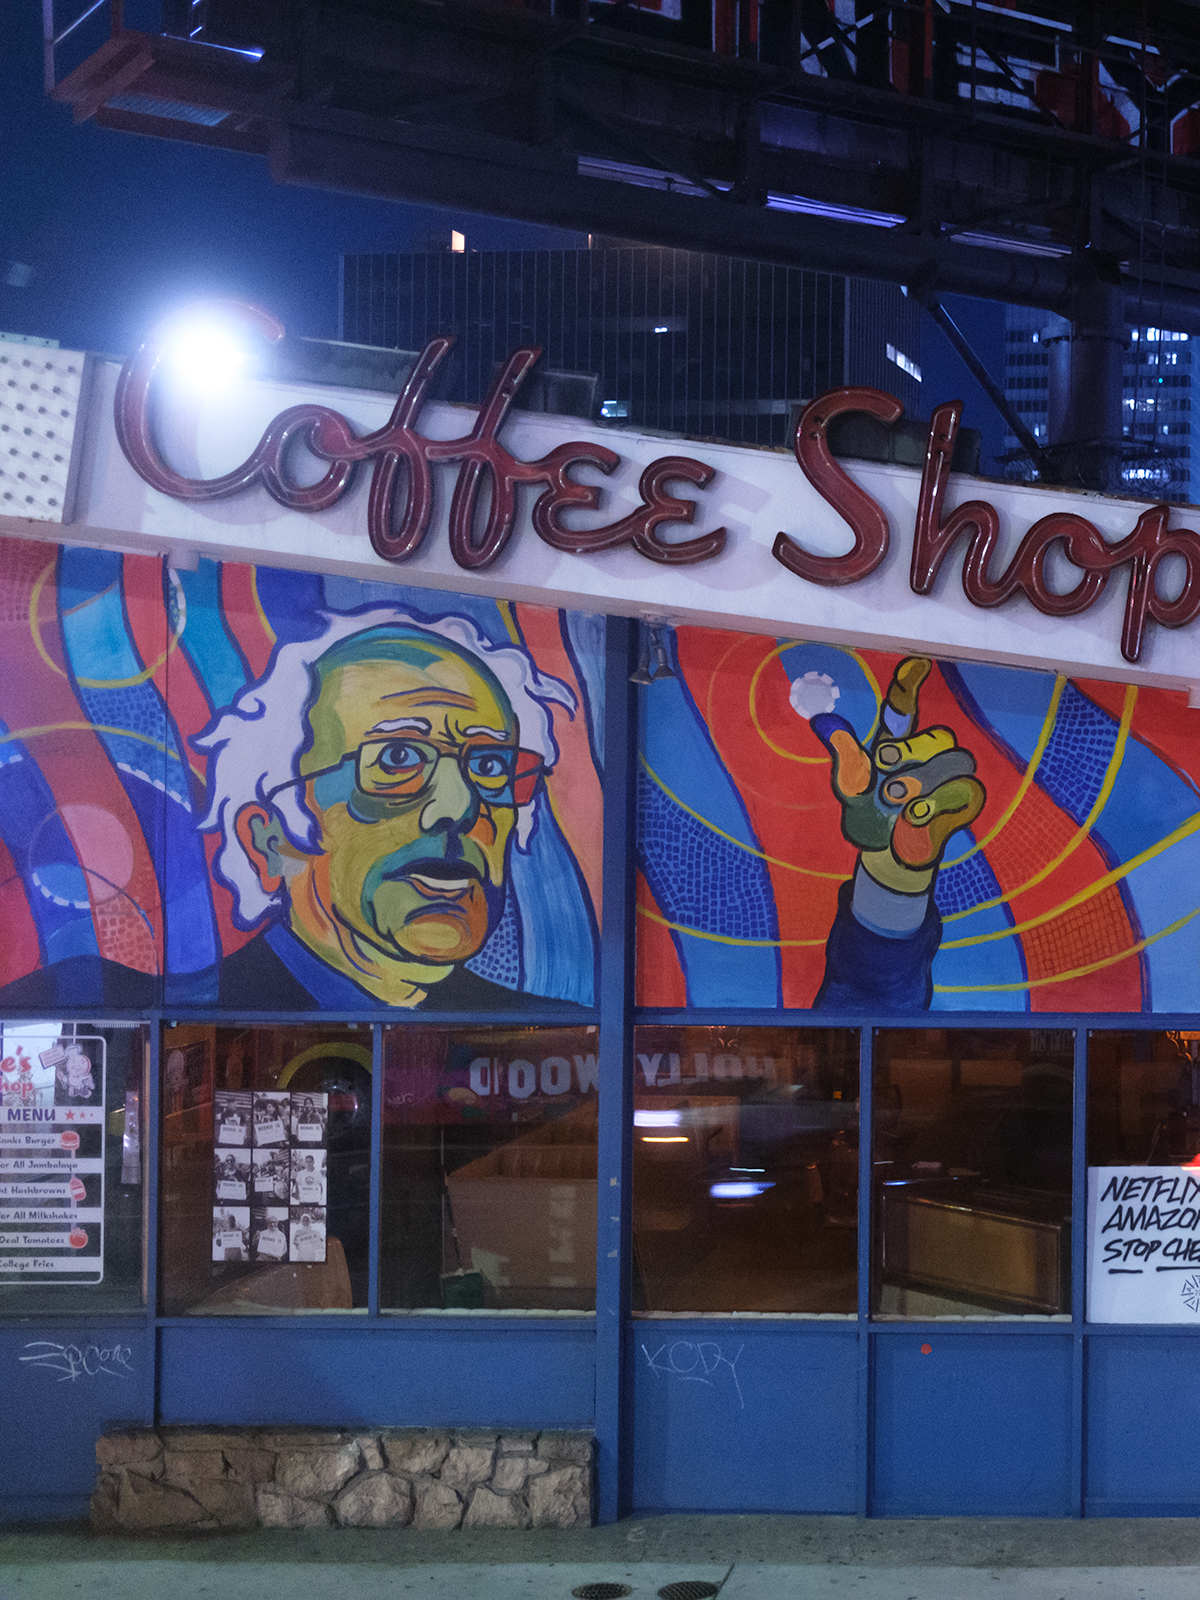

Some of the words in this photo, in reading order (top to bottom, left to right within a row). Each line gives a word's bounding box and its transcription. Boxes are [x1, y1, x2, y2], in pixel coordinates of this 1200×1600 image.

[112, 299, 728, 572] Coffee
[8, 1108, 56, 1121] MENU
[0, 1135, 21, 1144] anks
[25, 1135, 56, 1146] Burger
[13, 1160, 25, 1168] All
[28, 1160, 78, 1172] Jambalaya
[11, 1186, 66, 1195] Hashbrowns
[0, 1211, 11, 1219] or
[14, 1211, 26, 1219] All
[29, 1211, 78, 1219] Milkshakes
[23, 1235, 65, 1244] Tomatoes
[1102, 1238, 1162, 1263] STOP
[33, 1260, 54, 1268] Fries
